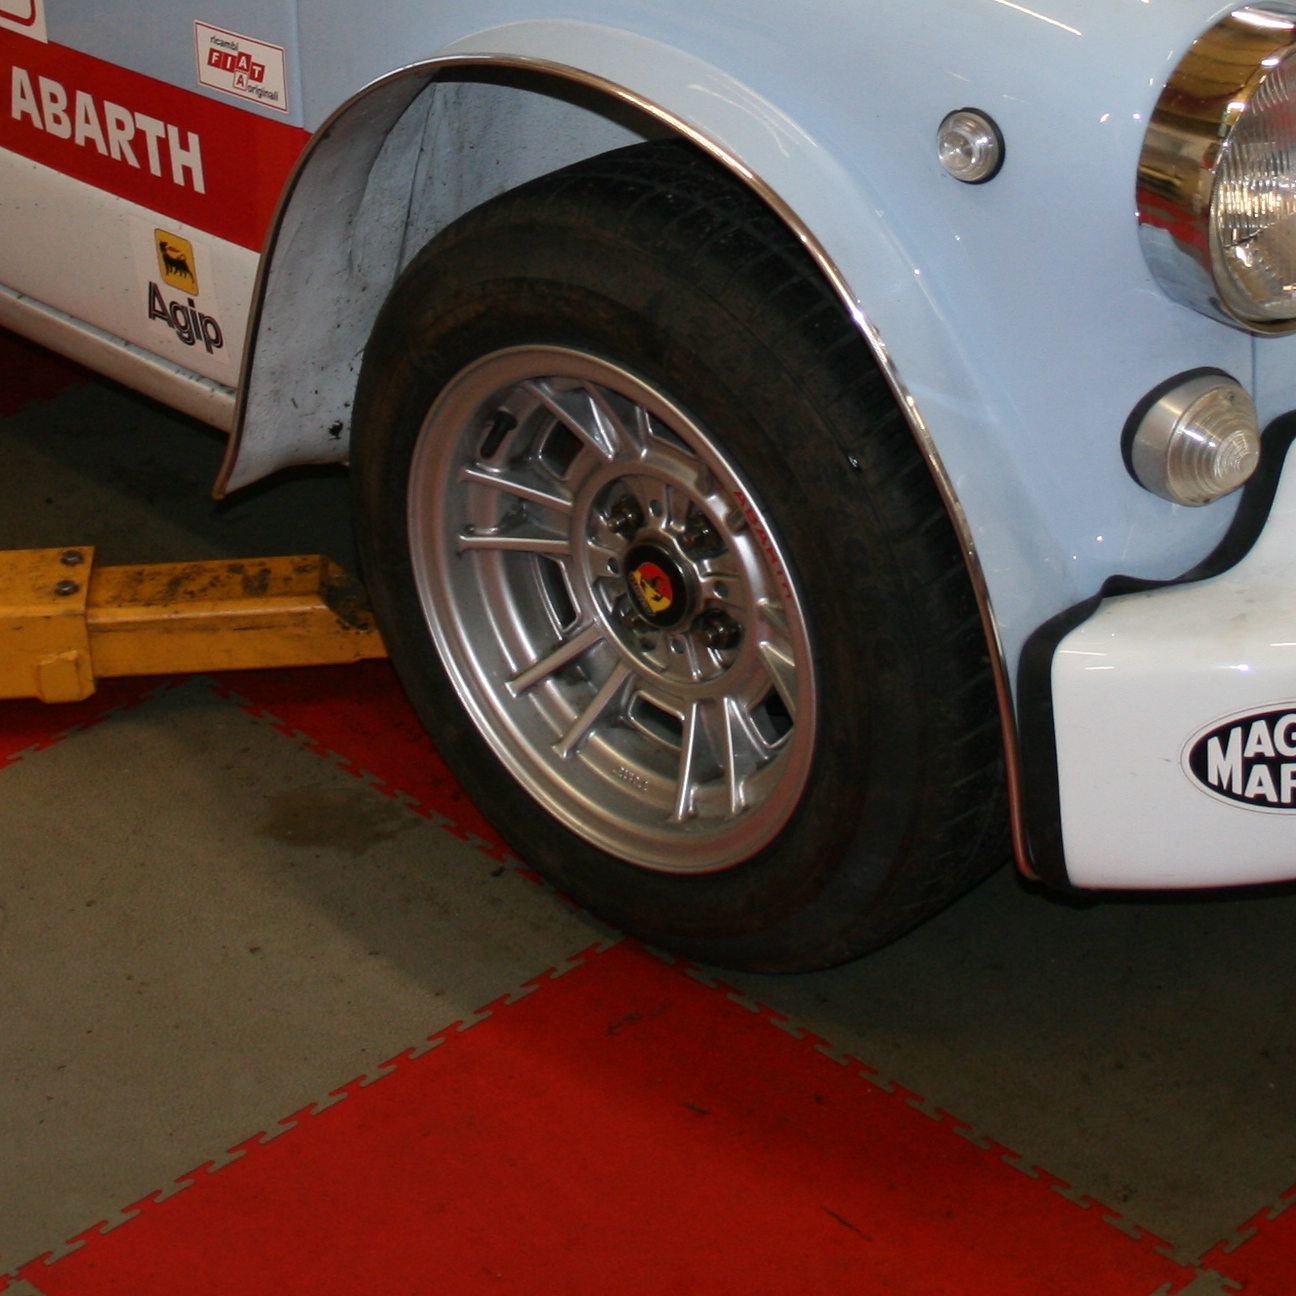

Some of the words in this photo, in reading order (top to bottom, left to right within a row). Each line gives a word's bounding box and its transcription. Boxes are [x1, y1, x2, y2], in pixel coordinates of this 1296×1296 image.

[210, 51, 263, 80] FIAT
[10, 65, 206, 195] ABARTH
[147, 280, 224, 355] Agip
